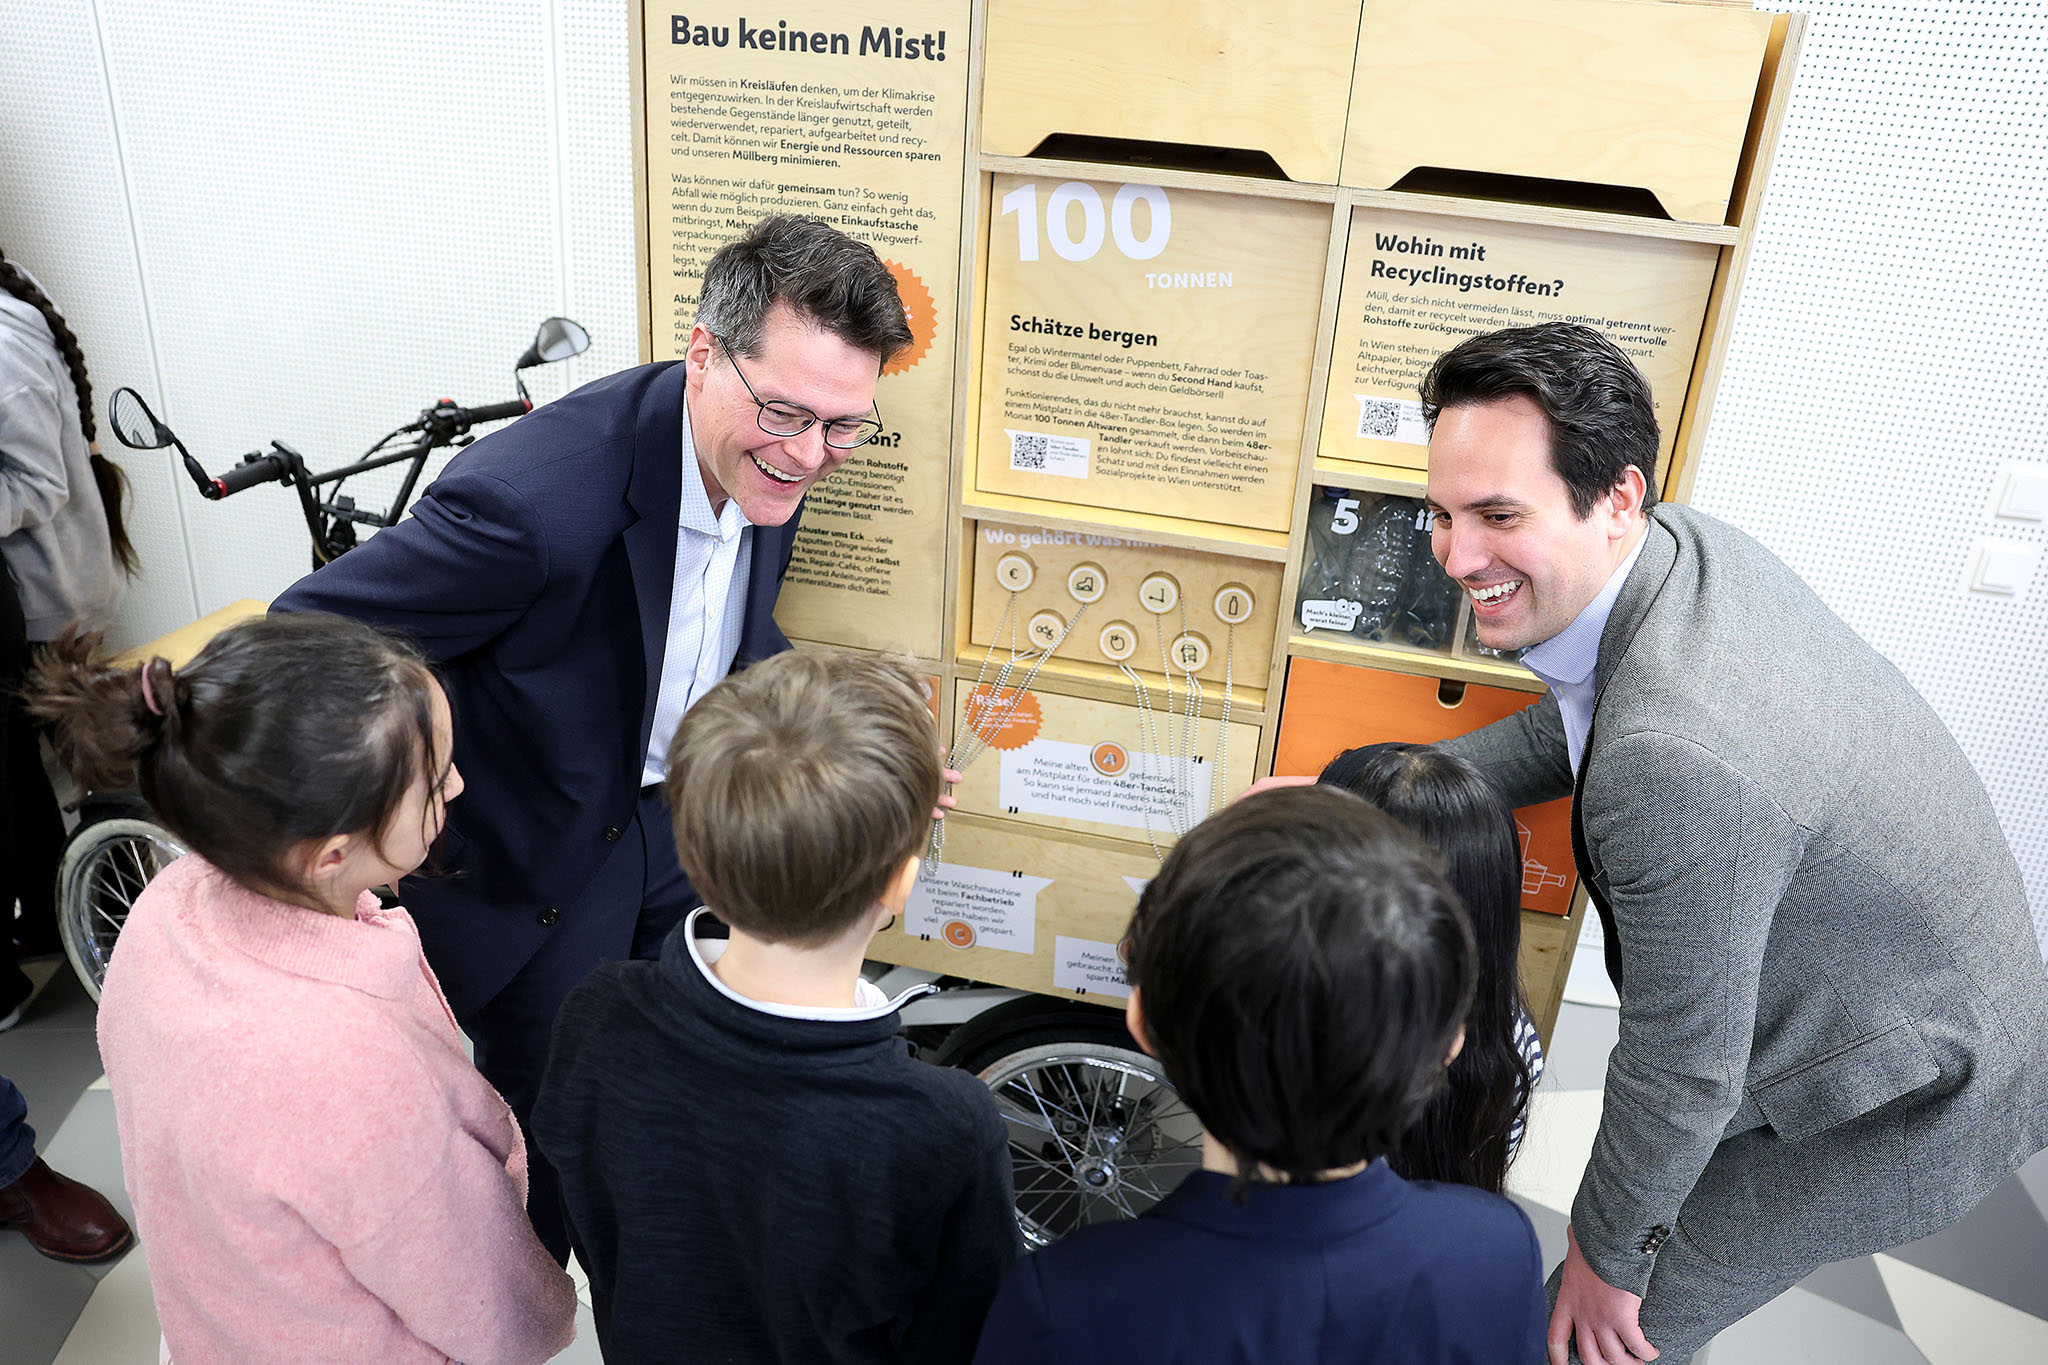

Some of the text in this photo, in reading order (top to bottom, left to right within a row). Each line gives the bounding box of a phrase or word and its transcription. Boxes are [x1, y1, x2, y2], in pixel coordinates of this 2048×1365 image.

[670, 15, 946, 60] Bau keinen Mist!
[669, 72, 935, 102] Wir müssen in Kreisläufen denken, um der Klimakrise
[670, 89, 933, 117] entgegenzuwirken. In der Kreislaufwirtschaft werden
[670, 101, 912, 131] bestehende Gegenstände länger genutzt, geteilt,
[670, 115, 927, 148] wiederverwendet, repariert, aufgearbeitet und recy-
[670, 130, 941, 162] celt. Damit können wir Energie und Ressourcen sparen
[670, 144, 841, 168] und unseren Müllberg minimieren.
[671, 171, 909, 205] Was können wir dafür gemeinsam tun? So wenig
[671, 184, 936, 220] Abfall wie möglich produzieren. Ganz einfach geht das,
[671, 201, 734, 215] wenn du zum
[672, 212, 723, 229] mitbringst,
[804, 210, 918, 231] eigene Einkaufstasche
[1001, 182, 1172, 261] 100
[1374, 231, 1486, 261] Wohin mit
[1145, 272, 1233, 288] TONNEN
[1371, 258, 1564, 297] Recyclingstoffen?
[1362, 311, 1411, 328] Rohstoffe
[1364, 300, 1505, 327] den, damit er recycelt werden
[1366, 287, 1676, 335] Müll, der sich nicht vermeiden lässt, muss optimal getrennt wer-
[1010, 313, 1158, 349] Schätze bergen
[1619, 333, 1667, 346] wertvolle
[1357, 349, 1403, 366] Altpapier,
[1359, 336, 1429, 355] In Wien stehen
[1007, 341, 1269, 381] Egal ob Wintermantel oder Puppenbett, Fahrrad oder Toas-
[1007, 353, 1264, 394] ter, Krimi oder Blumenvase wenn du Second Hand kaufst,
[1006, 365, 1224, 399] schonst du die Umwelt und auch dein Geldbörserl!
[1005, 386, 1267, 428] Funktionierendes, das du nicht mehr brauchst, kannst du auf
[1034, 411, 1128, 433] 100 Tonnen Altwaren
[1097, 430, 1268, 462] Tandler verkauft werden. Vorbeischau-
[1246, 438, 1272, 452] 48er-
[867, 459, 908, 471] Rohstoffe
[824, 496, 913, 516] lange genutzt werden
[1330, 498, 1361, 535] 5
[985, 529, 1015, 544] Wo
[1019, 530, 1081, 548] gehört
[876, 557, 899, 567] selbst
[1033, 755, 1089, 772] Meine alten
[1103, 752, 1117, 766] A
[960, 890, 1015, 906] Fachbetrieb
